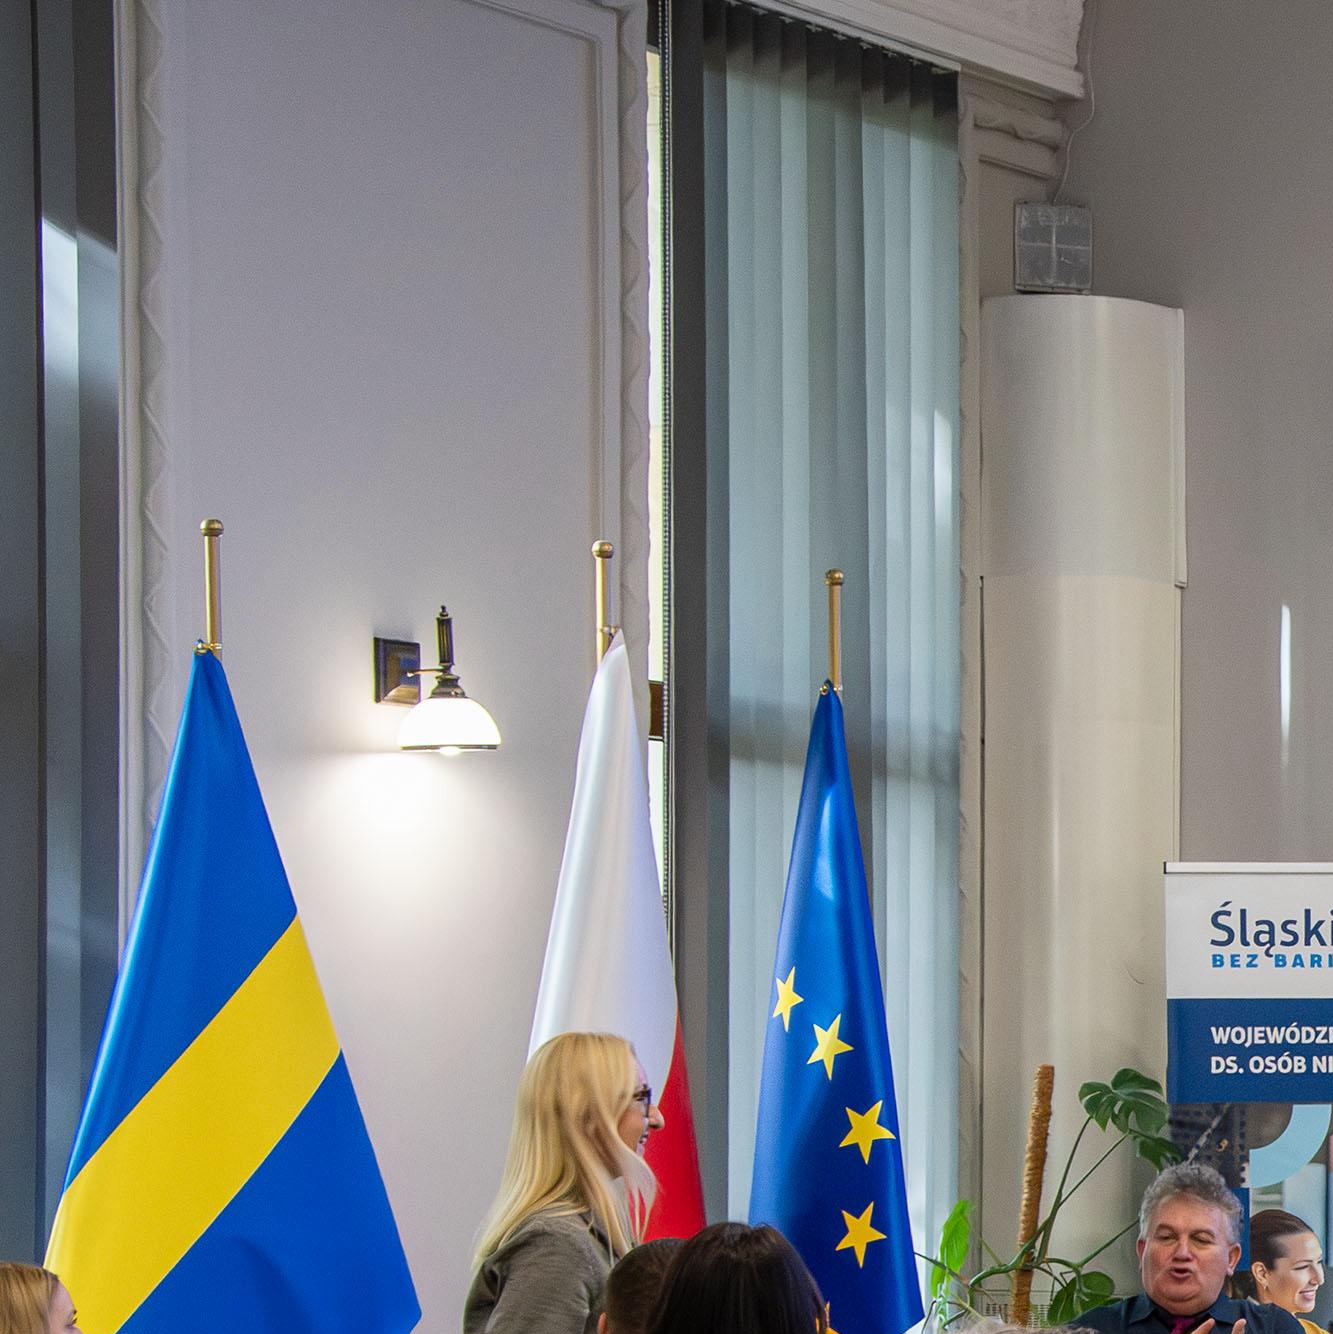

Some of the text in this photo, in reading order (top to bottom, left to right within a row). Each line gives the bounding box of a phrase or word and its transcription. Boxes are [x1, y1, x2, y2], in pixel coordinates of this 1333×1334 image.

[1212, 953, 1259, 968] BEZ
[1211, 1056, 1244, 1074] DS.
[1249, 1051, 1306, 1074] OSÓB
